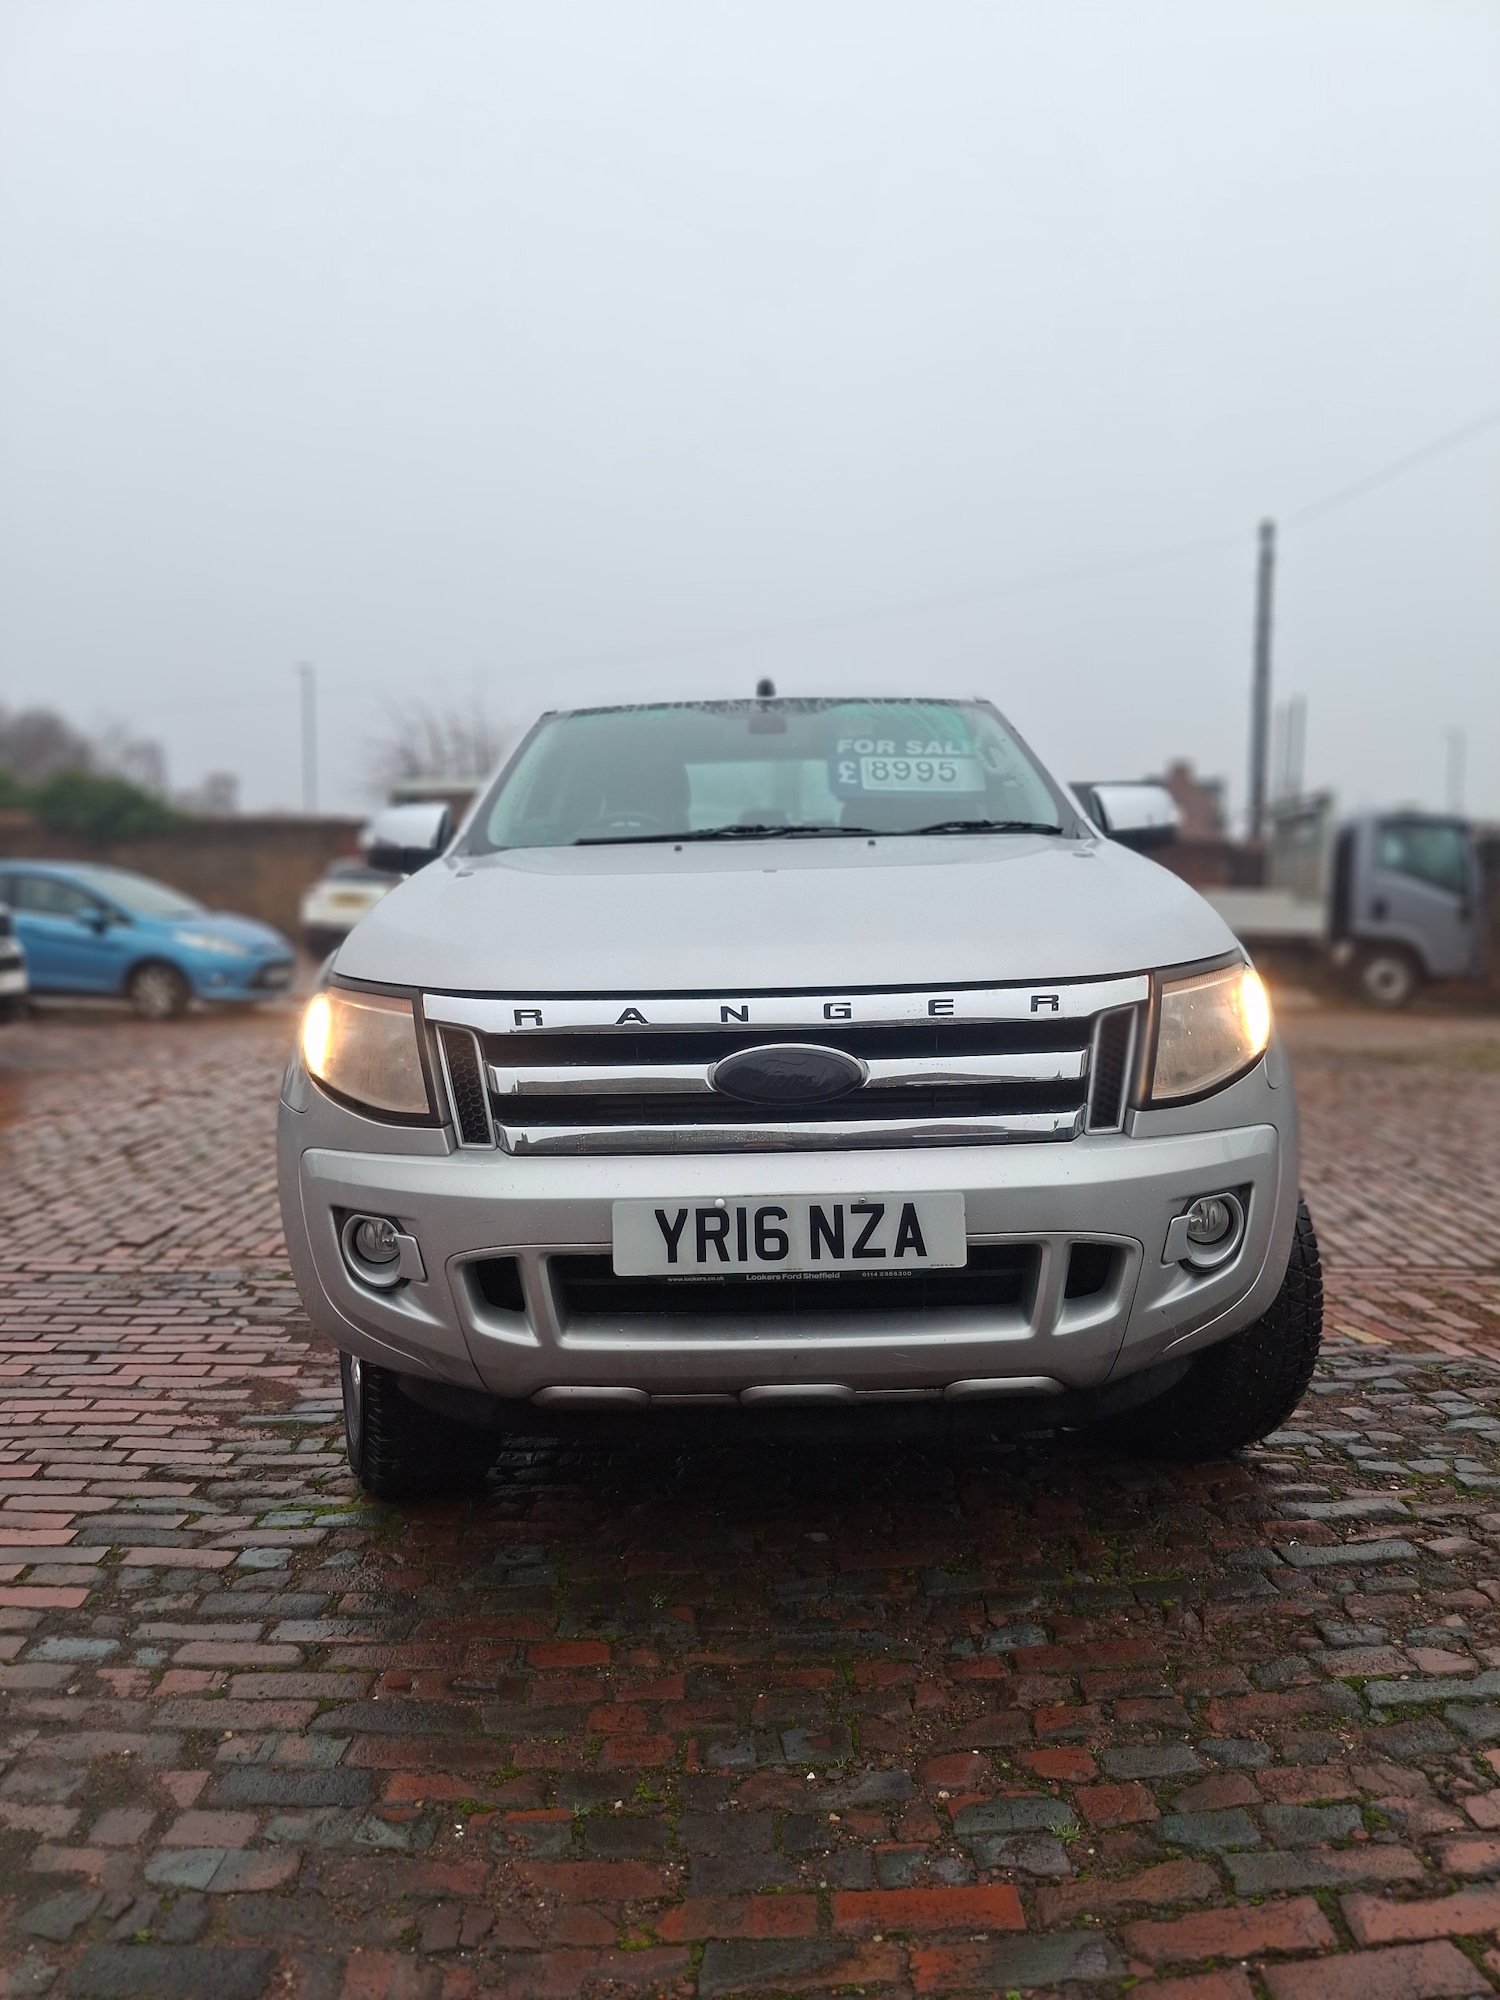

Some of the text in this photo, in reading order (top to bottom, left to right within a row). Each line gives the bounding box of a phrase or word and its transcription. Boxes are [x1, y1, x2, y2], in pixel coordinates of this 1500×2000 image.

[837, 739, 896, 754] FOR
[871, 760, 957, 782] 8995
[514, 994, 1060, 1027] RANGER
[749, 1058, 829, 1088] Ford
[654, 1202, 928, 1263] YR16 NZA
[746, 1271, 840, 1281] Lookers Ford Sheffield
